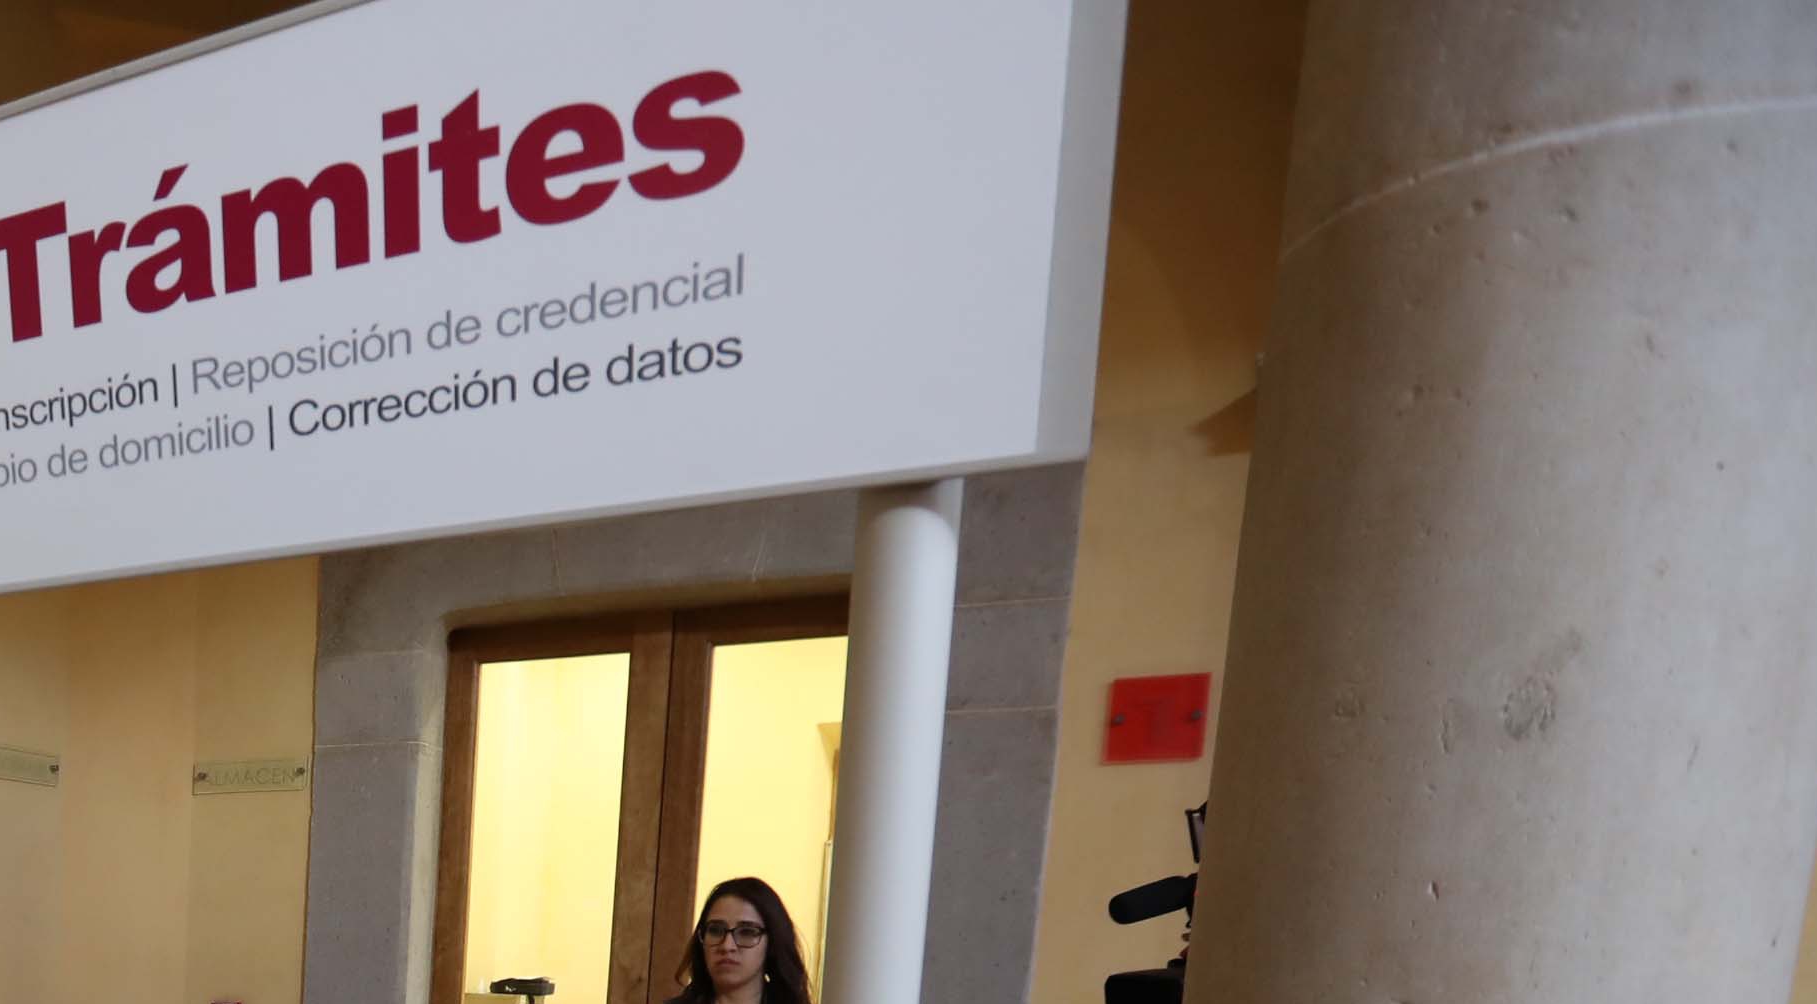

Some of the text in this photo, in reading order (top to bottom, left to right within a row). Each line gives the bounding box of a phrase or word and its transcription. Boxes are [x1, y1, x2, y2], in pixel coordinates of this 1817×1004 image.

[192, 324, 411, 394] Reposición
[426, 310, 481, 350] de
[496, 253, 744, 338] credencial
[47, 443, 88, 478] de
[99, 416, 254, 469] domicilio
[289, 370, 516, 436] Corrección
[533, 357, 590, 397] de
[606, 337, 743, 386] datos
